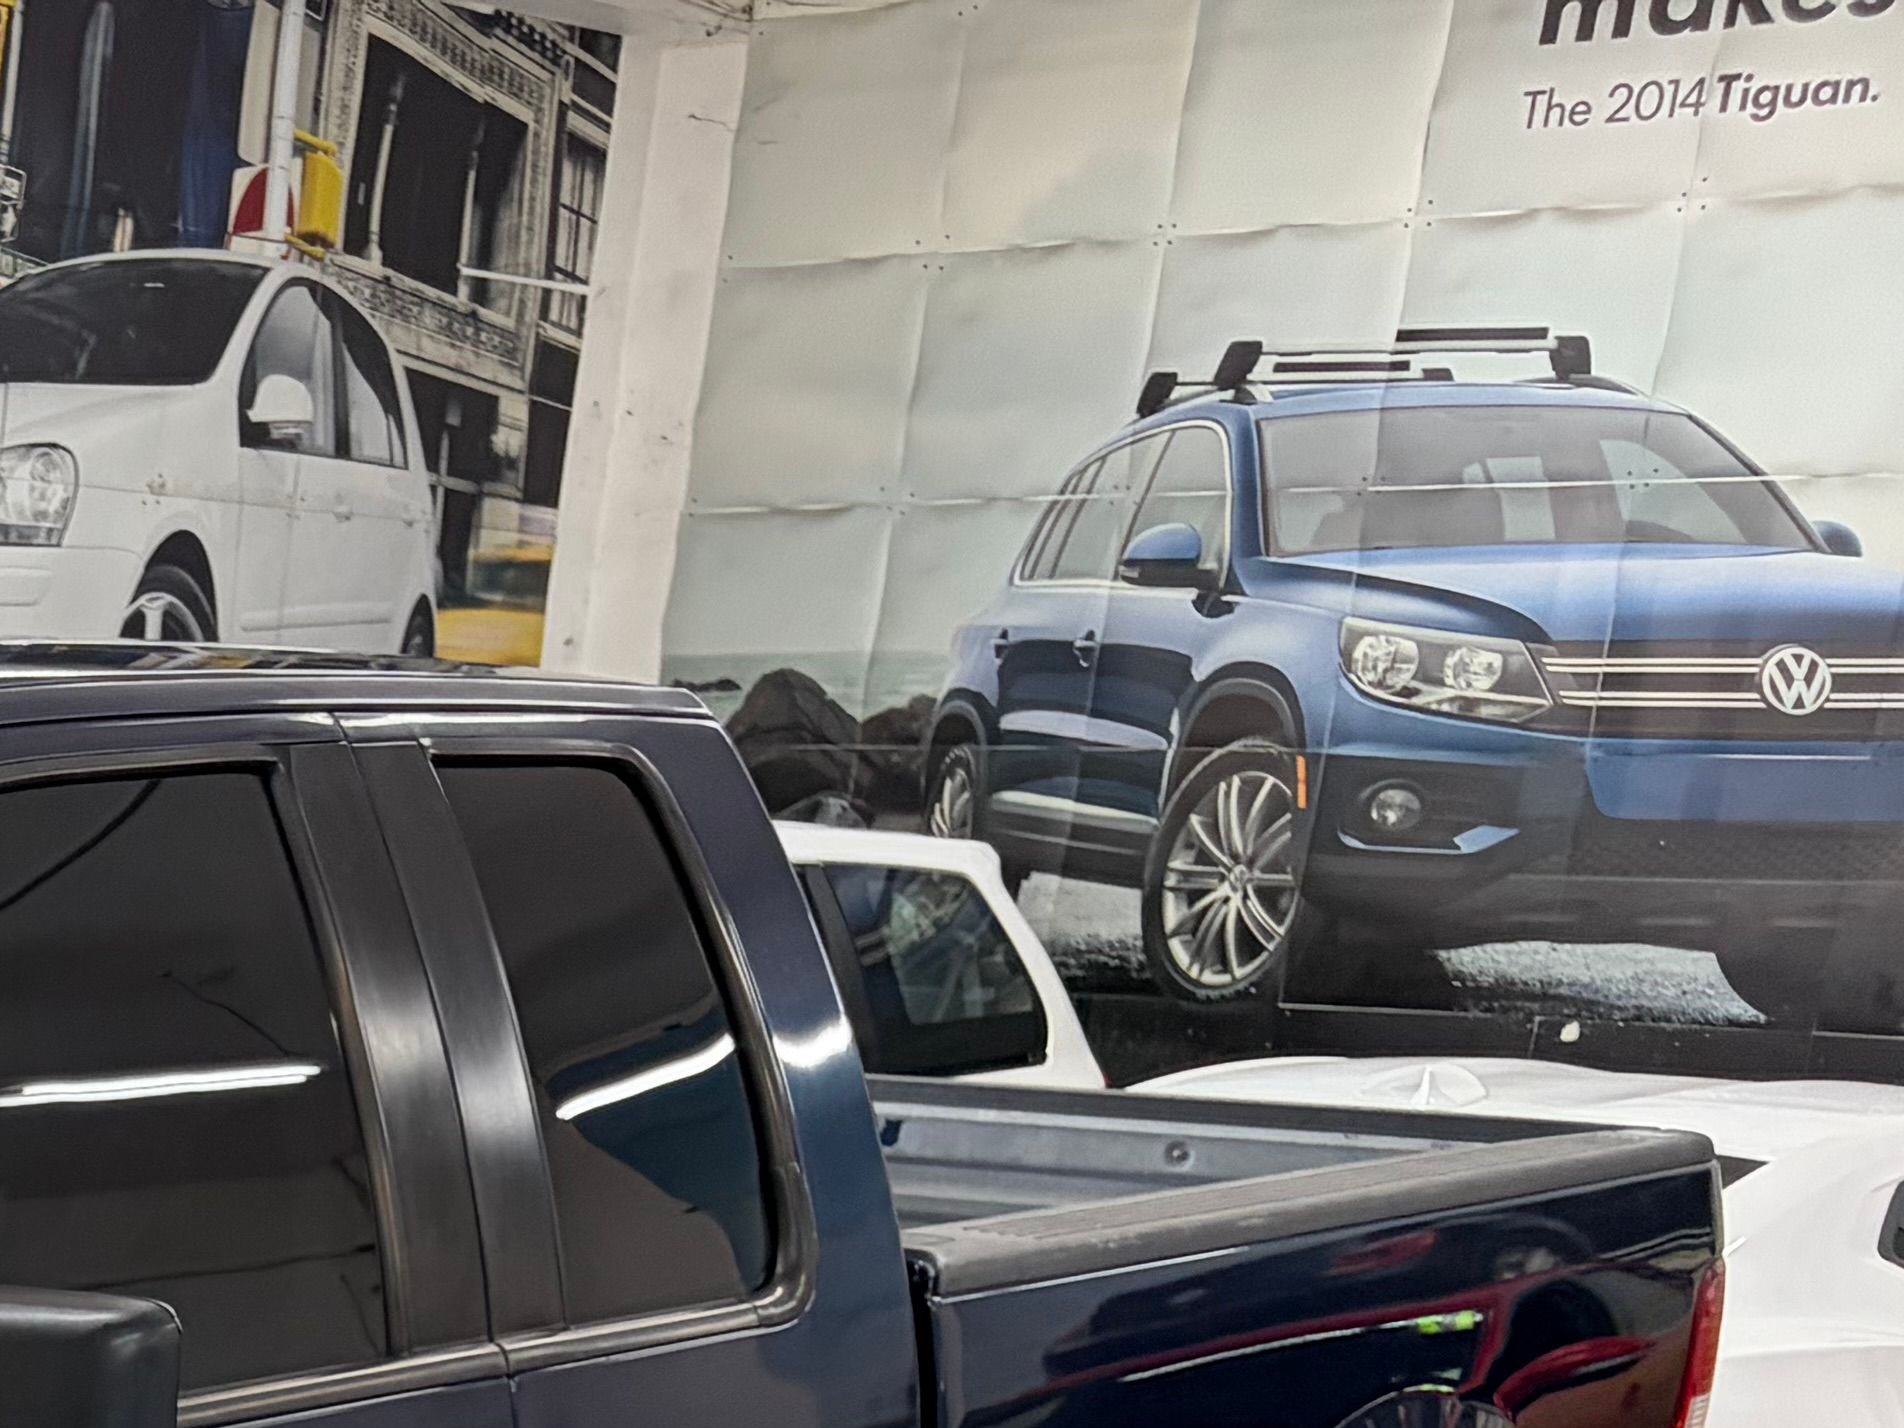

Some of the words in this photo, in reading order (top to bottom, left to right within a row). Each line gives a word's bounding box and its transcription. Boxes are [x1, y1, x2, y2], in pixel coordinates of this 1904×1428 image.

[1523, 87, 1592, 129] The
[1604, 76, 1706, 124] 2014
[1716, 73, 1880, 122] Tiguan.
